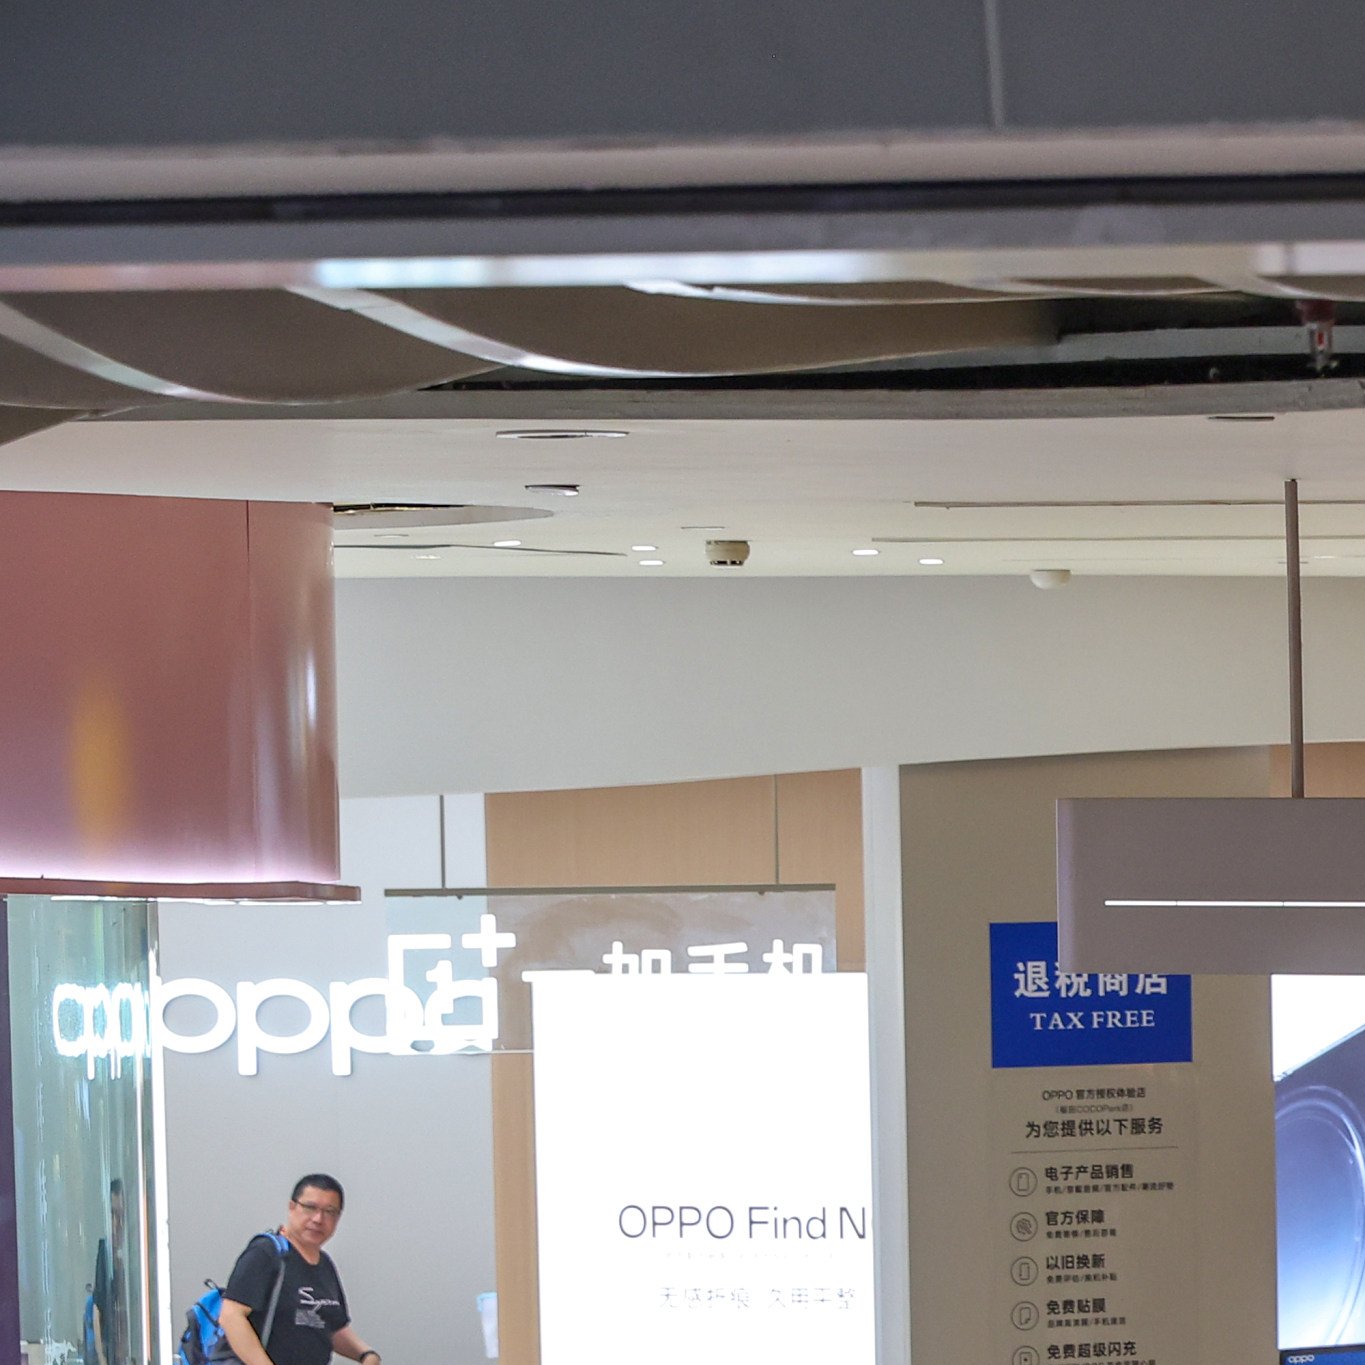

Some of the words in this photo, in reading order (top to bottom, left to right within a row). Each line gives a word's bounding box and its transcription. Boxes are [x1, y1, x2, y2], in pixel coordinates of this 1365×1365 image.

[1030, 1011, 1085, 1030] TAX
[1092, 1009, 1156, 1028] FREE
[1025, 1116, 1163, 1139] 为您提供以下服务
[1045, 1163, 1134, 1181] 电子产品销售
[619, 1204, 734, 1239] OPPO
[748, 1206, 826, 1239] Find
[840, 1206, 866, 1239] N
[1045, 1209, 1105, 1226] 官方保障
[1046, 1253, 1106, 1270] 以旧换新
[1046, 1298, 1106, 1316] 免费贴膜
[1288, 1355, 1315, 1363] oppo
